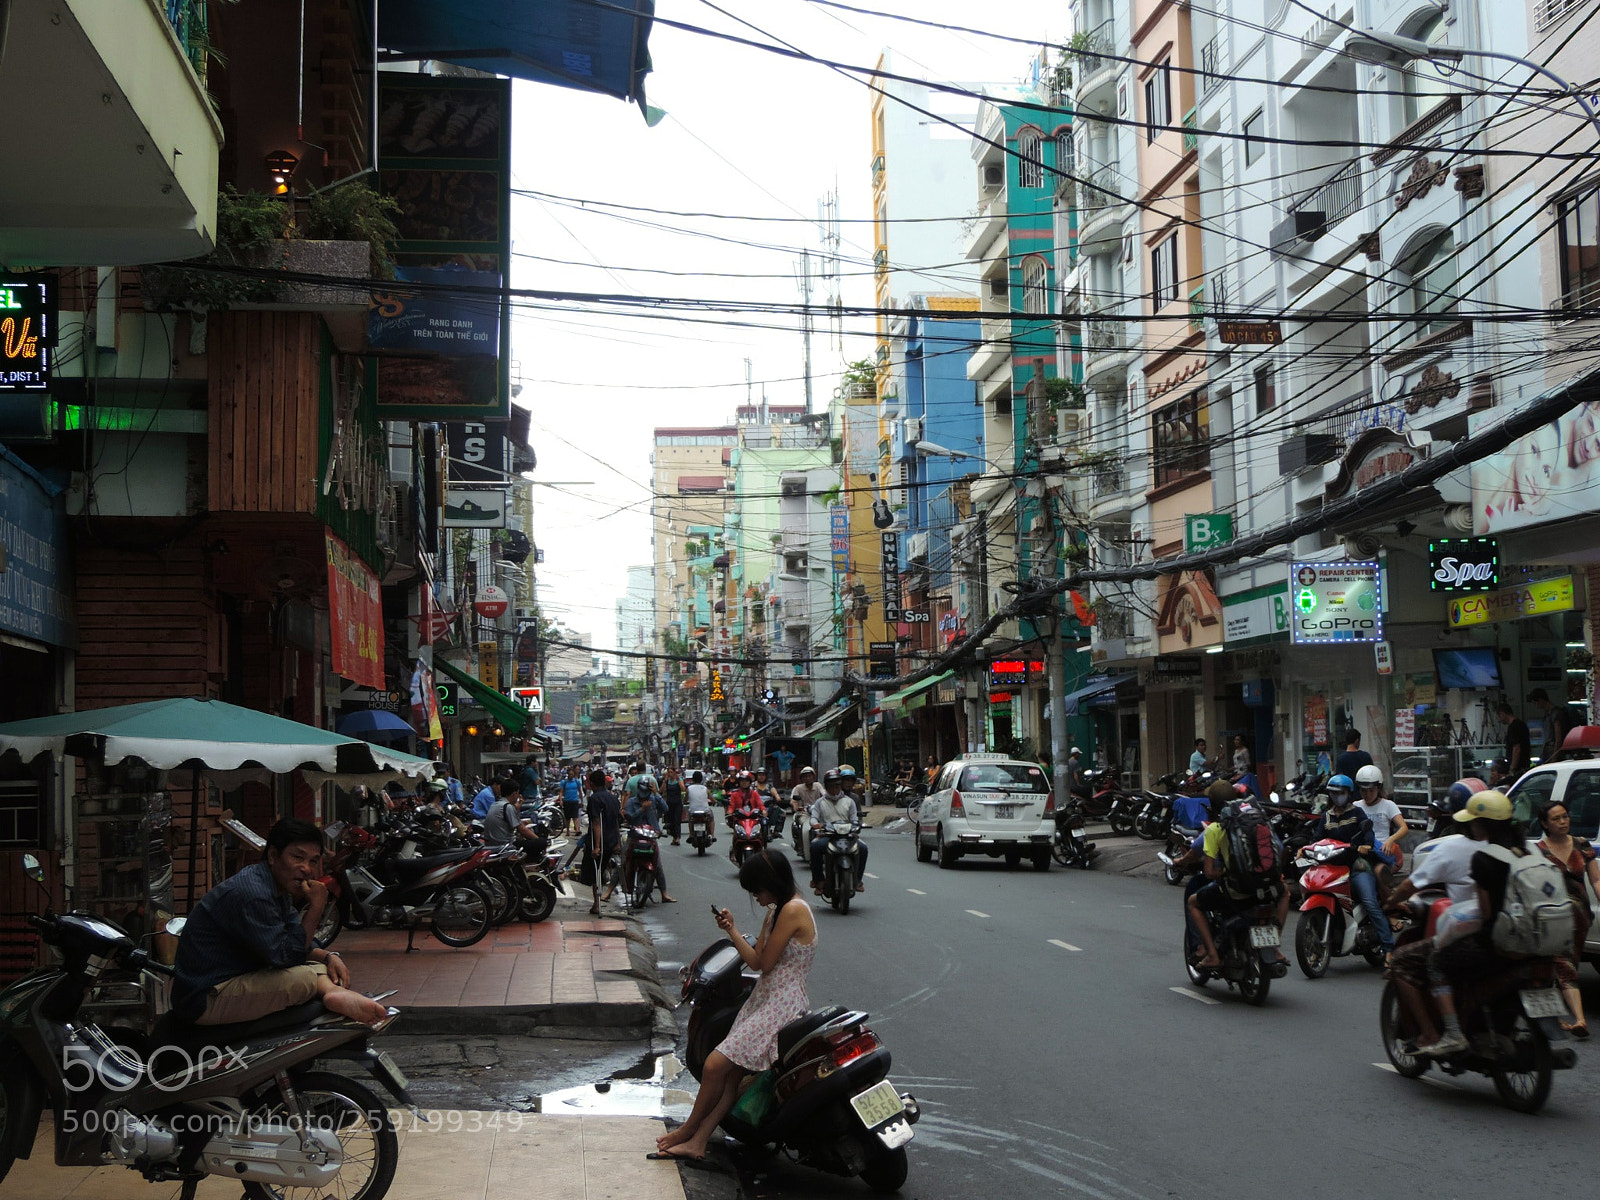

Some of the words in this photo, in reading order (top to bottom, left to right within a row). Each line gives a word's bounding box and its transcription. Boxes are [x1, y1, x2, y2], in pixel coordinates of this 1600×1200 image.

[452, 319, 472, 328] DANH
[413, 328, 432, 338] TRÊN
[435, 329, 454, 339] TOÀN
[10, 371, 32, 381] DIST
[832, 536, 848, 551] 96
[883, 533, 898, 620] UNIVERSAL
[1434, 557, 1493, 587] Spa
[1462, 590, 1535, 613] CAMERA
[905, 610, 929, 623] Spa
[1301, 617, 1374, 630] GoPro
[369, 701, 399, 710] HOUSE
[866, 1098, 898, 1123] 3558
